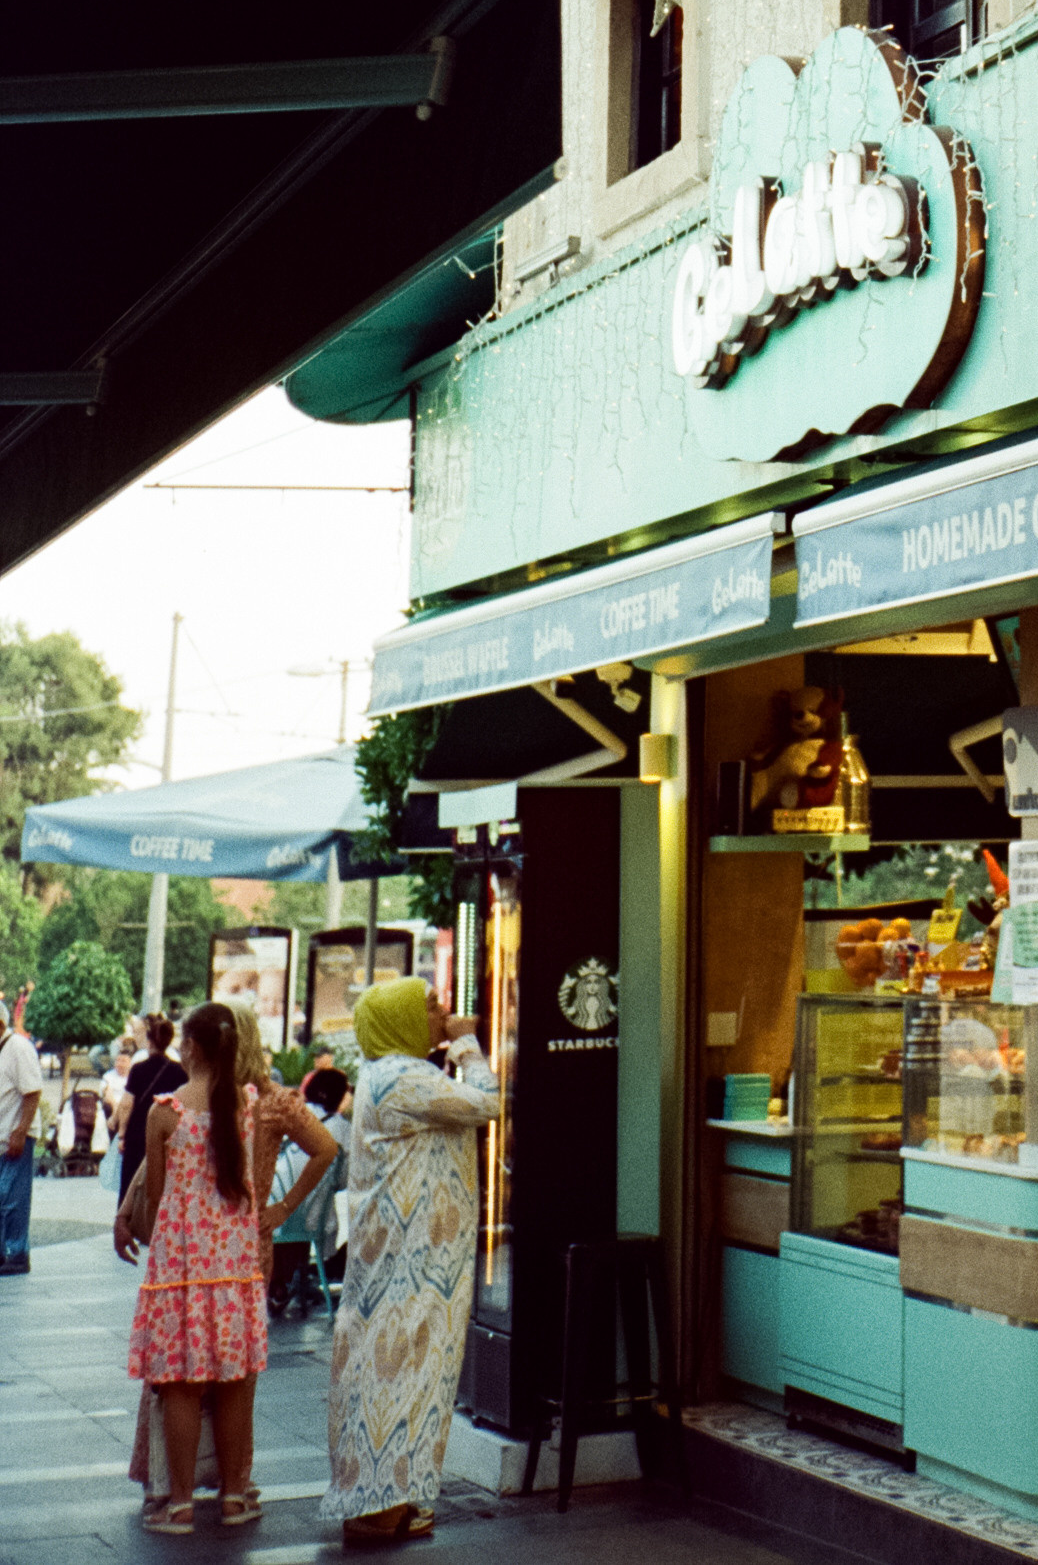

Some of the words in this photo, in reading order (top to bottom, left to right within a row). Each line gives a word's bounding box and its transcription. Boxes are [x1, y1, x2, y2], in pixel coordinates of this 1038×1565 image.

[901, 501, 1027, 574] HOMEMADE
[601, 591, 647, 640] COFFEE
[648, 581, 681, 626] TIME
[130, 835, 180, 860] COFFEE
[181, 837, 215, 863] TIME
